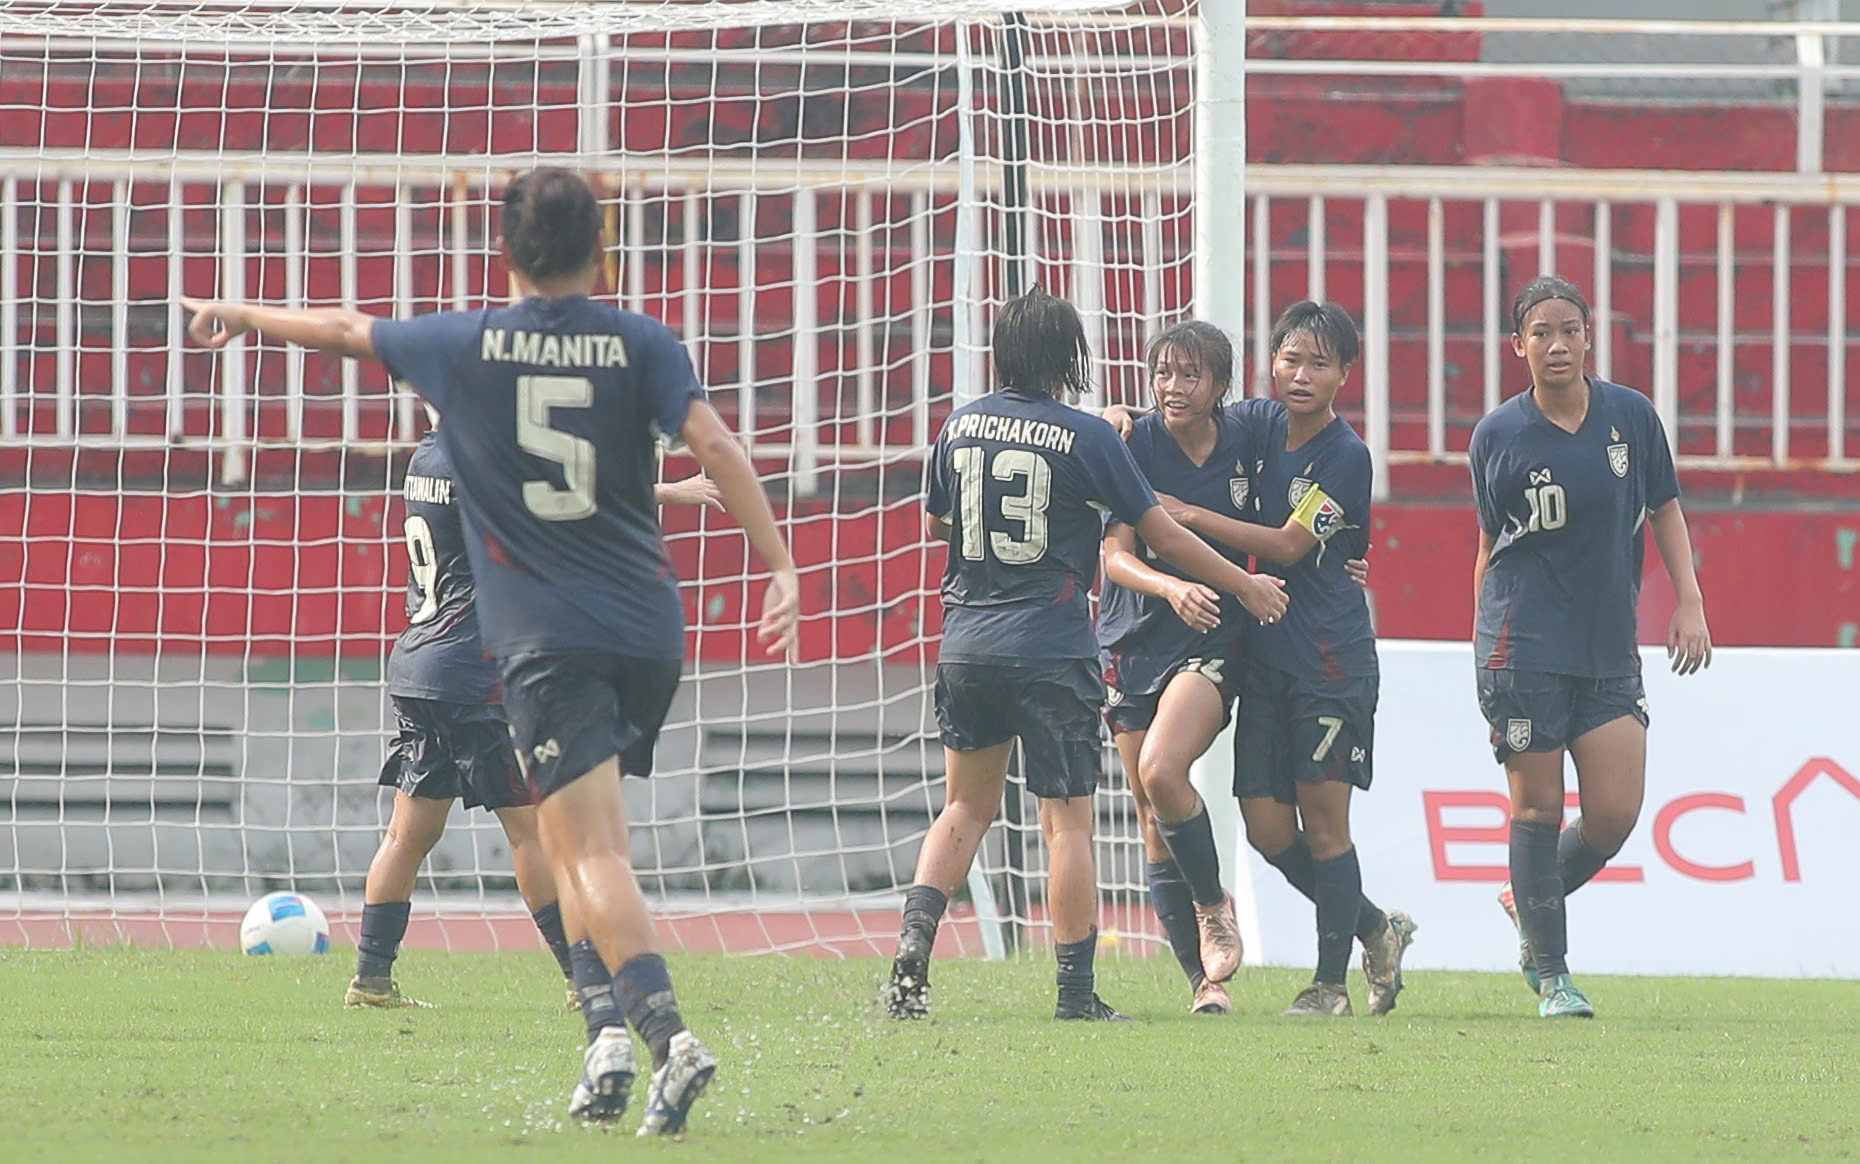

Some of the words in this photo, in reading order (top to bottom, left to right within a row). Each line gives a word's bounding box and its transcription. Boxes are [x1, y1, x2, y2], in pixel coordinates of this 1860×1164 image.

[482, 328, 628, 368] N.MANITA
[516, 375, 597, 522] 5
[953, 446, 1051, 565] 13
[1524, 484, 1568, 533] 10
[403, 514, 438, 624] 9
[1312, 716, 1344, 762] 7
